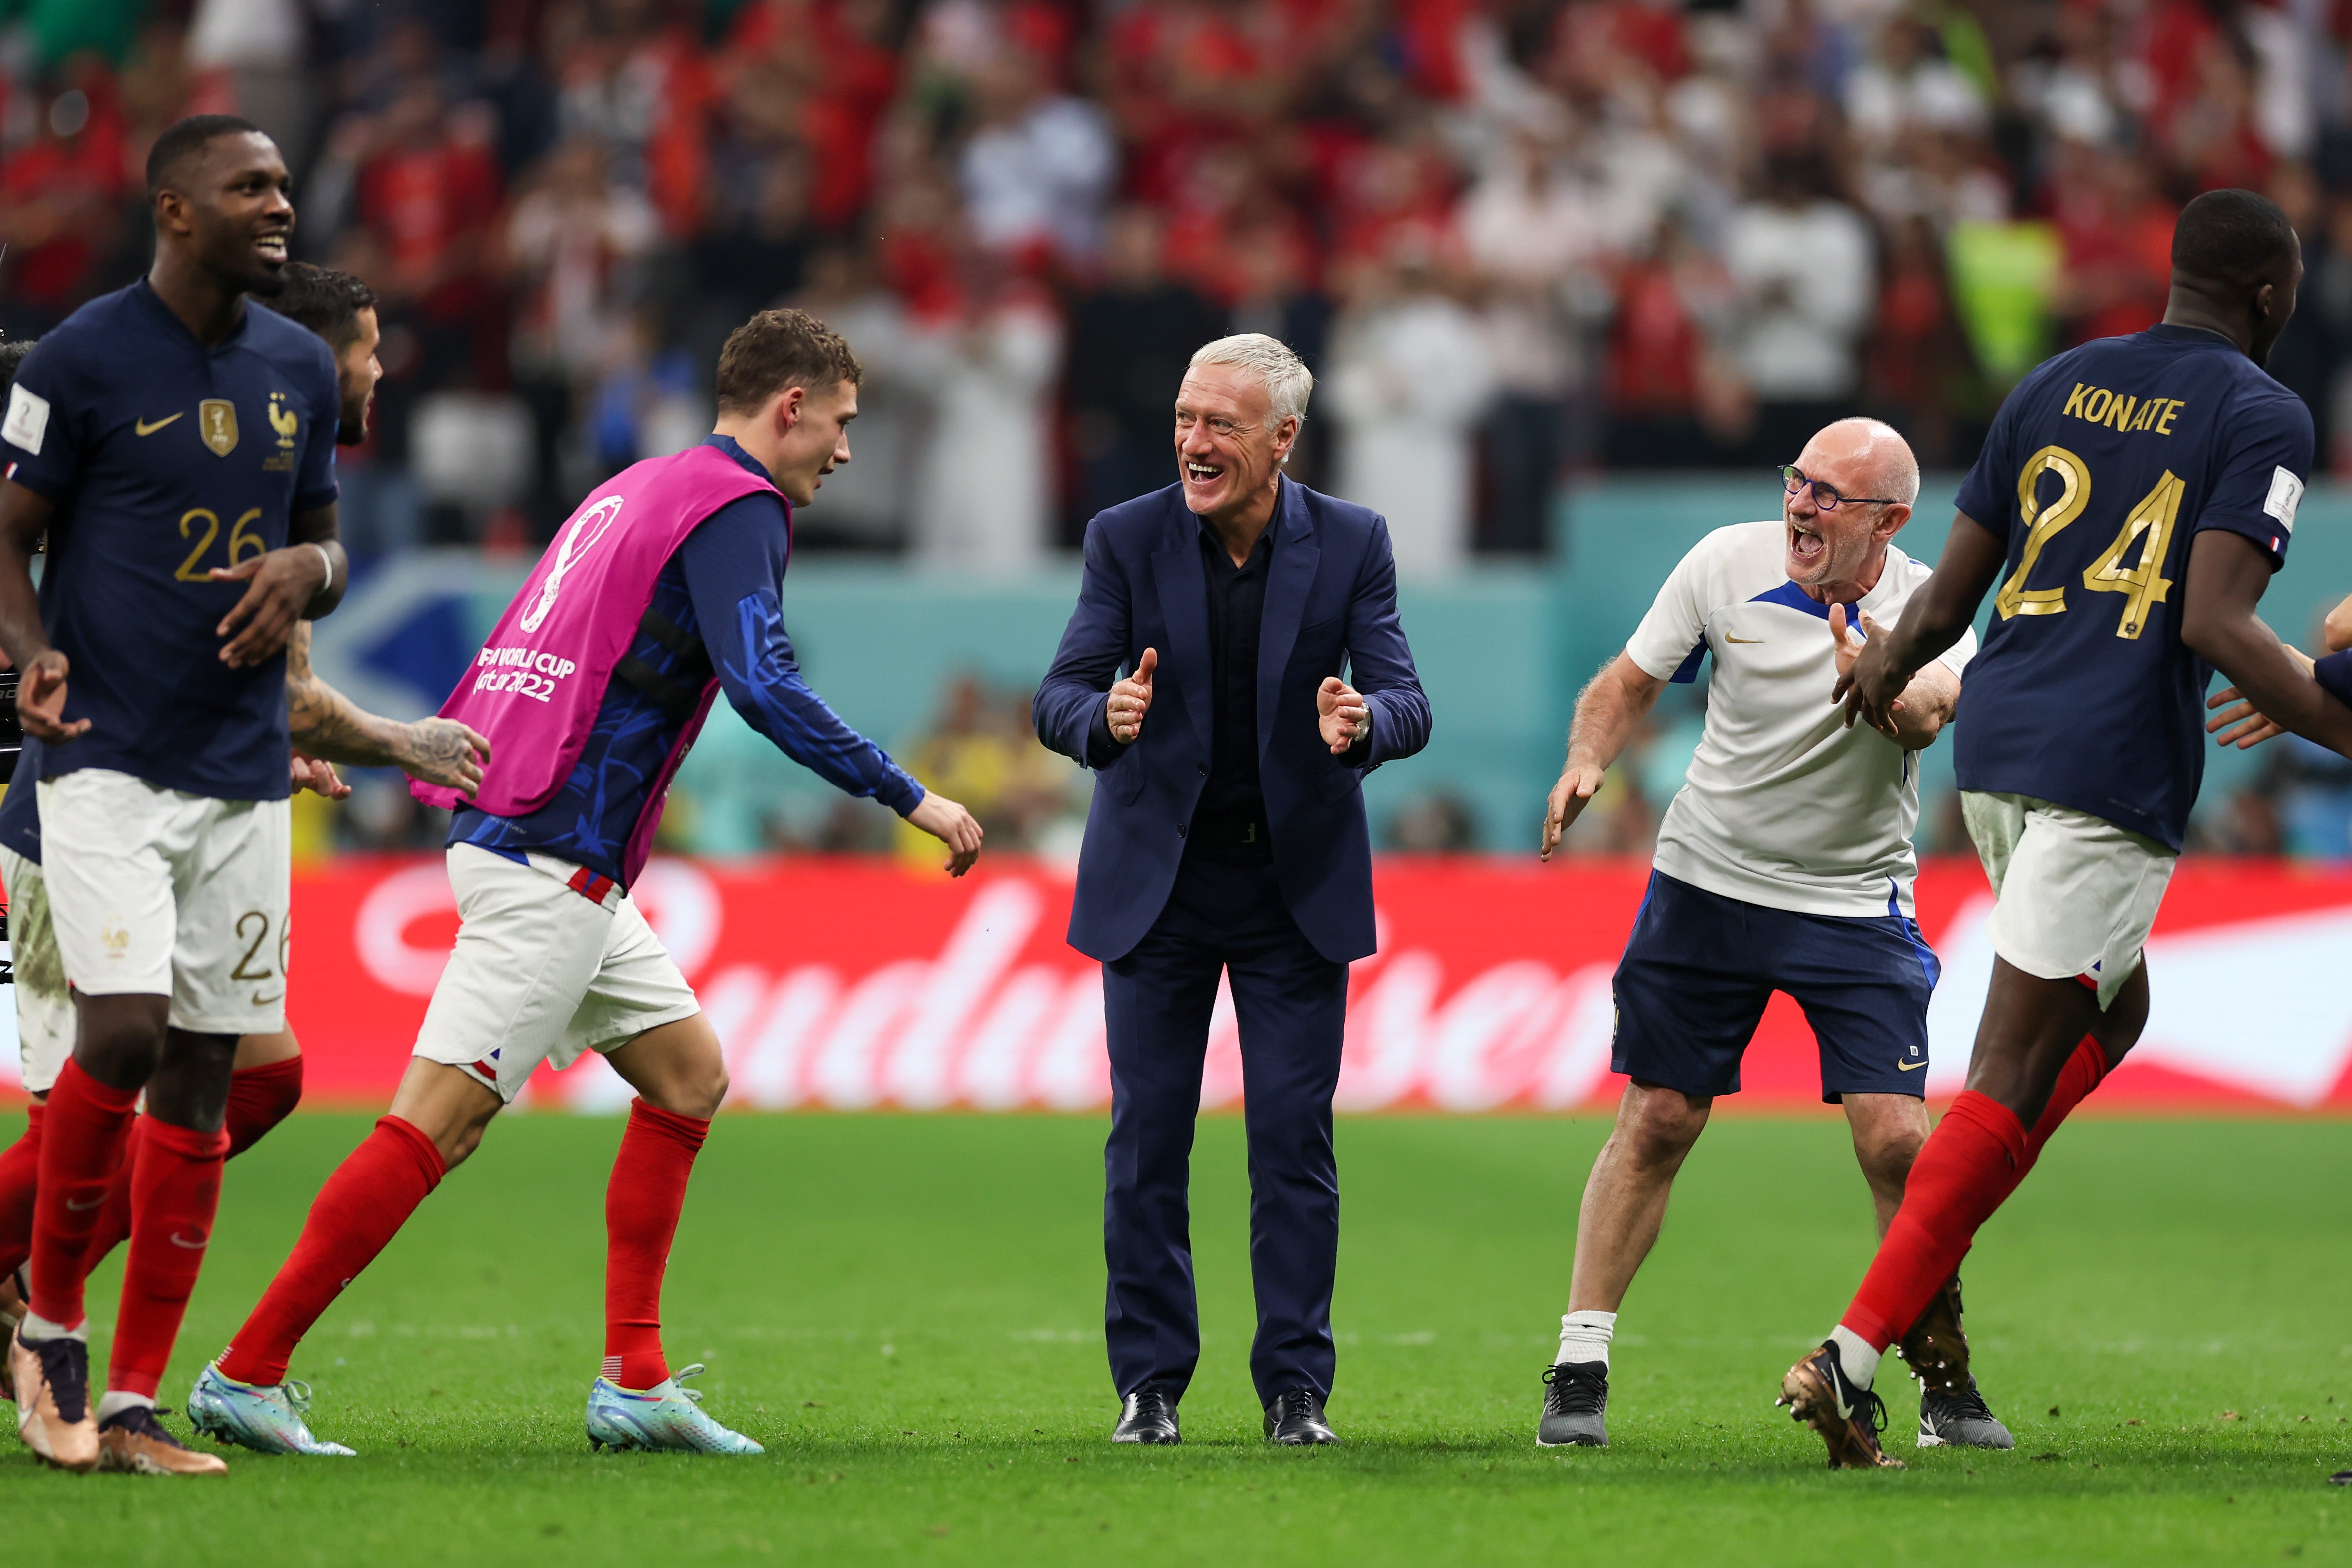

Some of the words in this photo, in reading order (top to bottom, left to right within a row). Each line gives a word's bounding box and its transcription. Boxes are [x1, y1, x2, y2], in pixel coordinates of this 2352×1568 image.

[2063, 383, 2186, 435] KONATE
[175, 508, 267, 581] 26
[1995, 445, 2186, 640] 24
[535, 653, 576, 679] CUP
